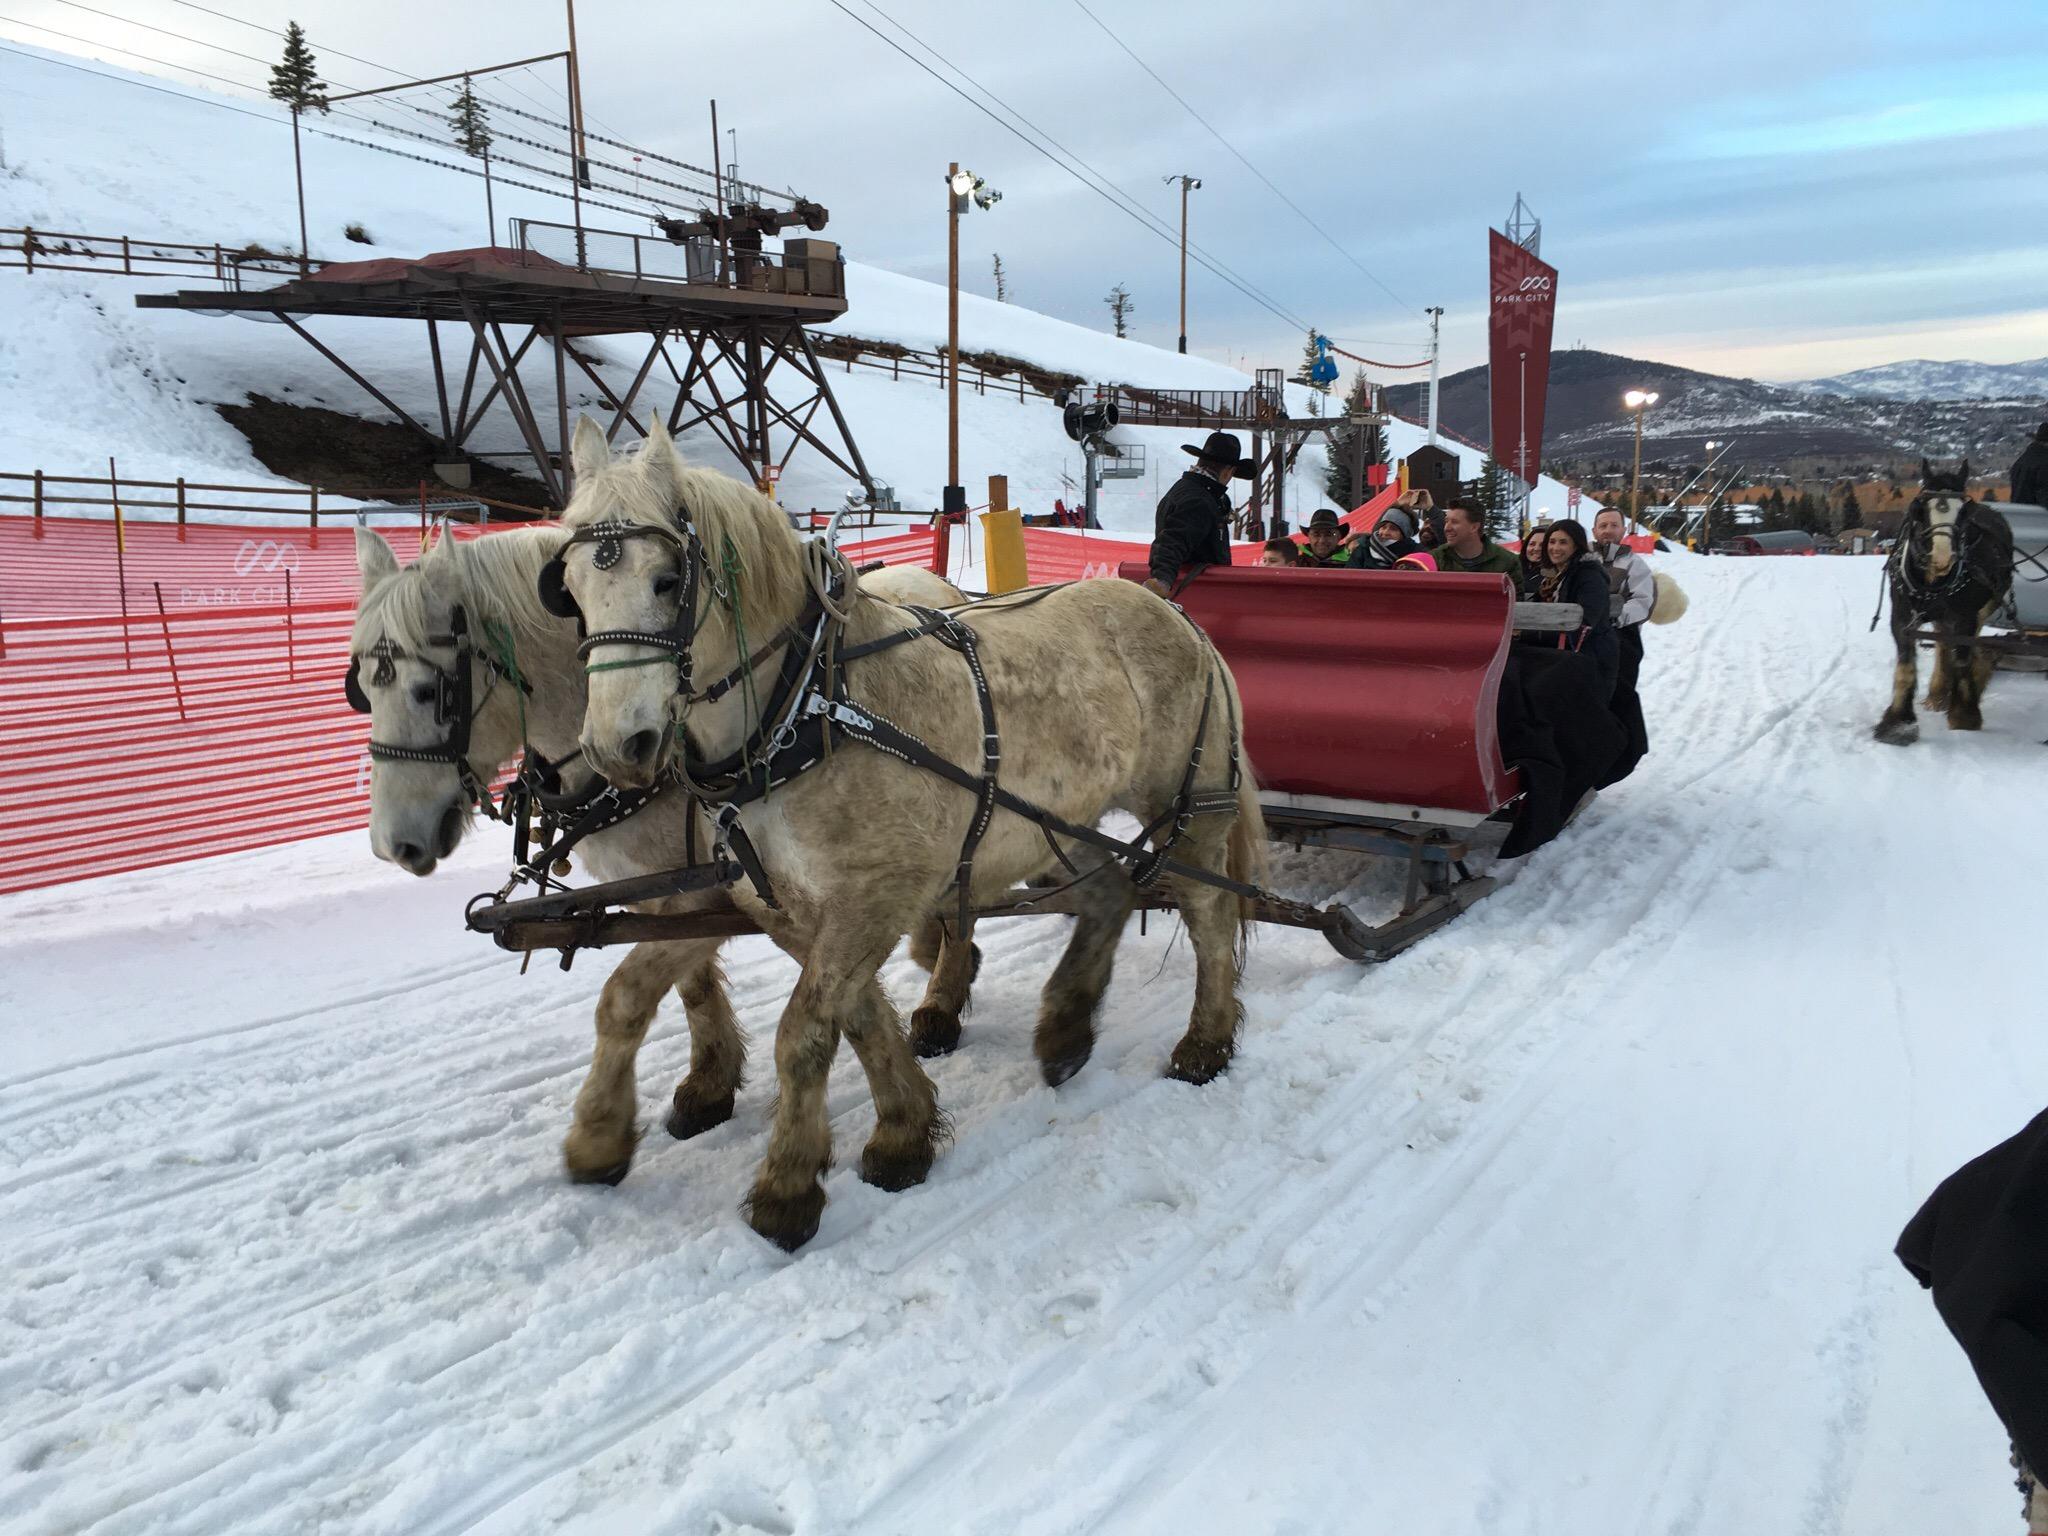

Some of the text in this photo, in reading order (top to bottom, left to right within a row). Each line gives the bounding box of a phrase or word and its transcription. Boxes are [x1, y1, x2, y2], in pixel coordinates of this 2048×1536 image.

[1495, 293, 1550, 304] PARK CITY
[181, 587, 240, 606] PARK
